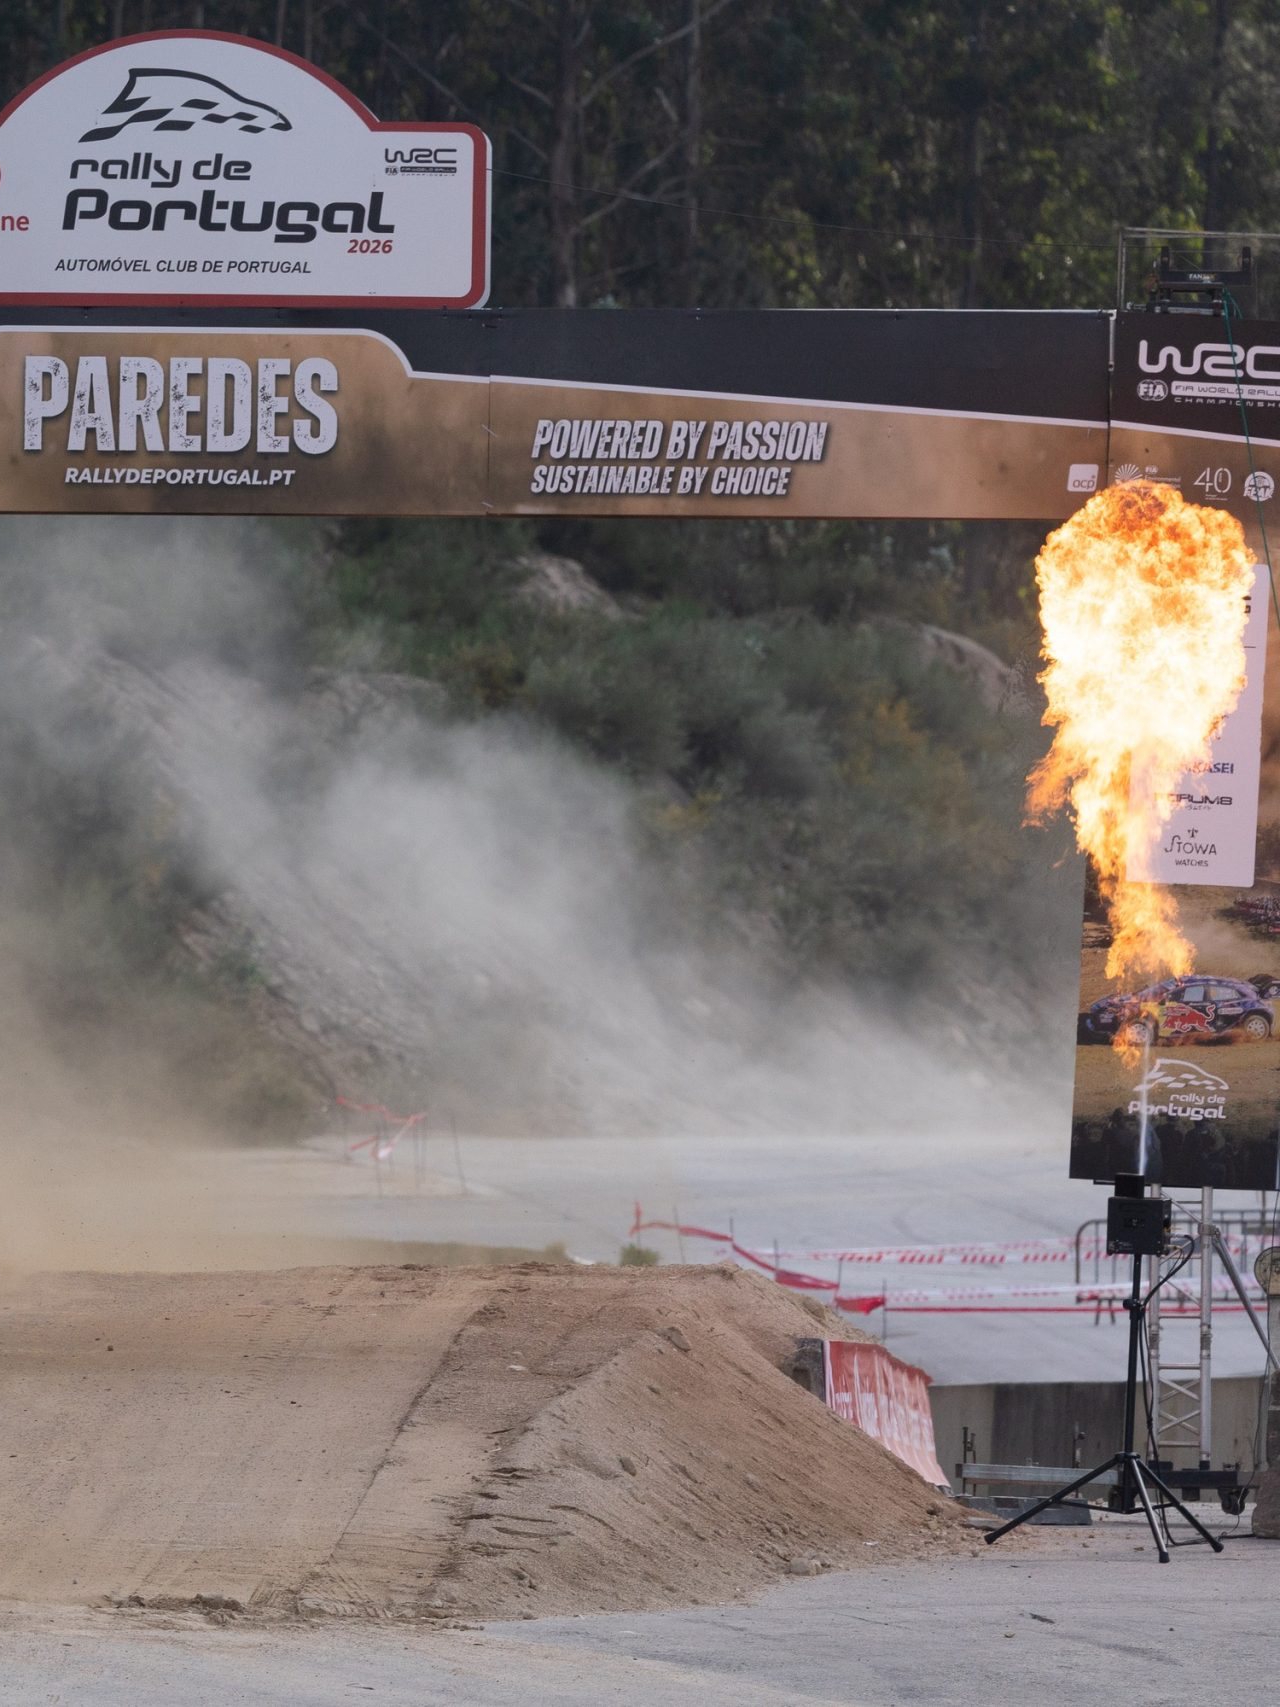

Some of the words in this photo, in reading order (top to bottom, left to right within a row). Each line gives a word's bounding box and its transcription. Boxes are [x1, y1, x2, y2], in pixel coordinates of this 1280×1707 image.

[384, 148, 457, 163] WRC
[70, 152, 181, 188] rally
[192, 153, 252, 181] de
[62, 189, 395, 243] Portugal
[347, 239, 393, 254] 2026
[55, 257, 152, 273] AUTOMÓVEL
[156, 260, 198, 273] CLUB
[202, 260, 223, 273] DE
[226, 260, 312, 274] PORTUGAL
[1139, 382, 1167, 398] FIA
[1248, 388, 1280, 396] RALL
[23, 356, 338, 455] PAREDES
[1174, 397, 1280, 407] CHAMPIONSH
[531, 419, 664, 460] POWERED
[666, 421, 706, 460] BY
[707, 421, 828, 461] PASSION
[65, 467, 295, 486] RALLYDEPORTUGAL.PT
[531, 465, 675, 494] SUSTAINABLE
[677, 466, 708, 495] BY
[711, 466, 791, 496] CHOICE
[1072, 475, 1095, 490] acp
[1193, 467, 1232, 494] 40
[1164, 835, 1217, 855] STOWA
[1175, 859, 1209, 867] WATCHES
[1169, 1093, 1204, 1105] rally
[1207, 1094, 1226, 1104] de
[1128, 1100, 1226, 1120] Portugal
